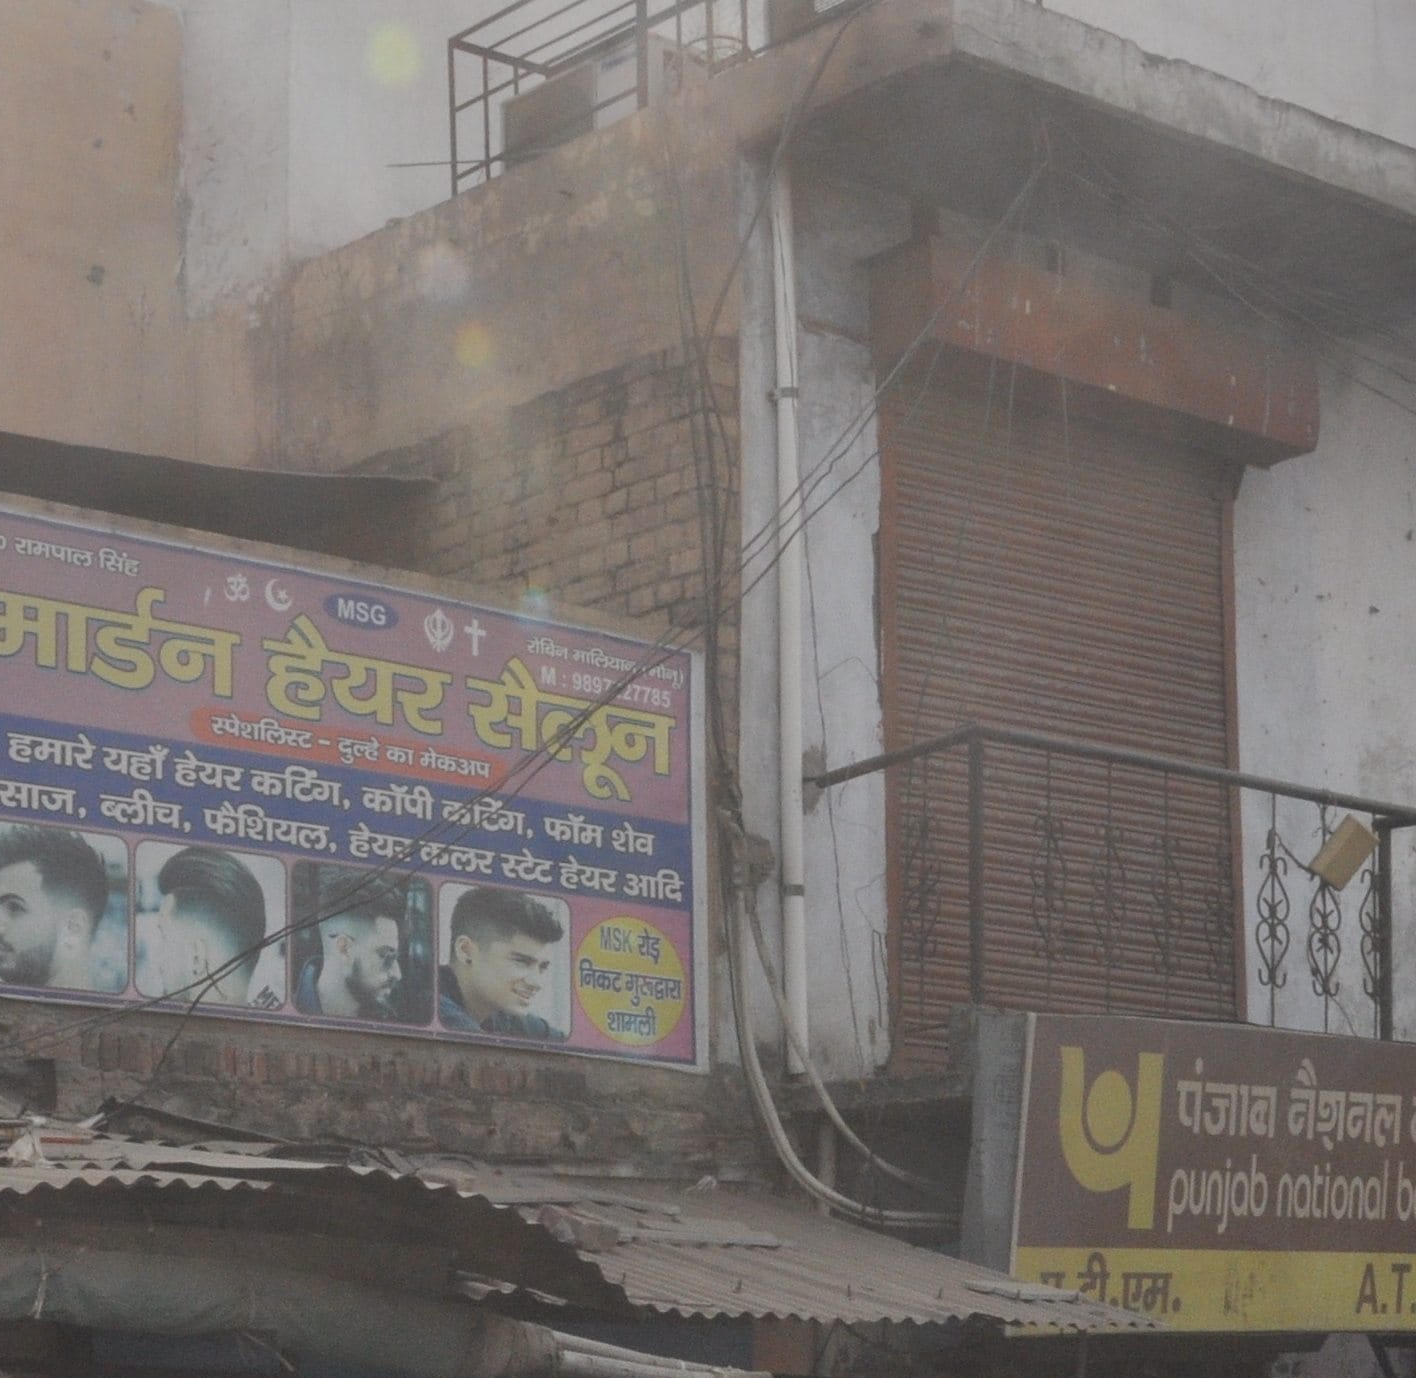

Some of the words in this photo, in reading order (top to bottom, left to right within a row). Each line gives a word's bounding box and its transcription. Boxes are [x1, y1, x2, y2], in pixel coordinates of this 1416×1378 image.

[13, 537, 94, 569] रामपाल
[98, 546, 142, 578] सिंह
[337, 598, 388, 627] MSG
[211, 713, 314, 750] स्पेशलिस्ट
[386, 746, 414, 766] का
[420, 747, 491, 779] मेकअप
[6, 731, 96, 771] हमारे
[102, 743, 170, 781] यहाँ
[174, 751, 244, 792] हेयर
[362, 783, 434, 821] कॉपी
[610, 821, 656, 857] शेव
[99, 788, 192, 833] ब्लीच,
[348, 821, 415, 864] हेयर
[418, 838, 496, 876] कलर
[558, 855, 619, 893] हेयर
[622, 867, 685, 904] आदि
[599, 926, 633, 954] MSK
[579, 957, 622, 993] निकट
[606, 1005, 657, 1037] शामली
[1175, 1055, 1279, 1140] पंजाब
[1286, 1057, 1404, 1152] नैशनल
[1166, 1154, 1269, 1236] punjab
[1276, 1159, 1389, 1222] national
